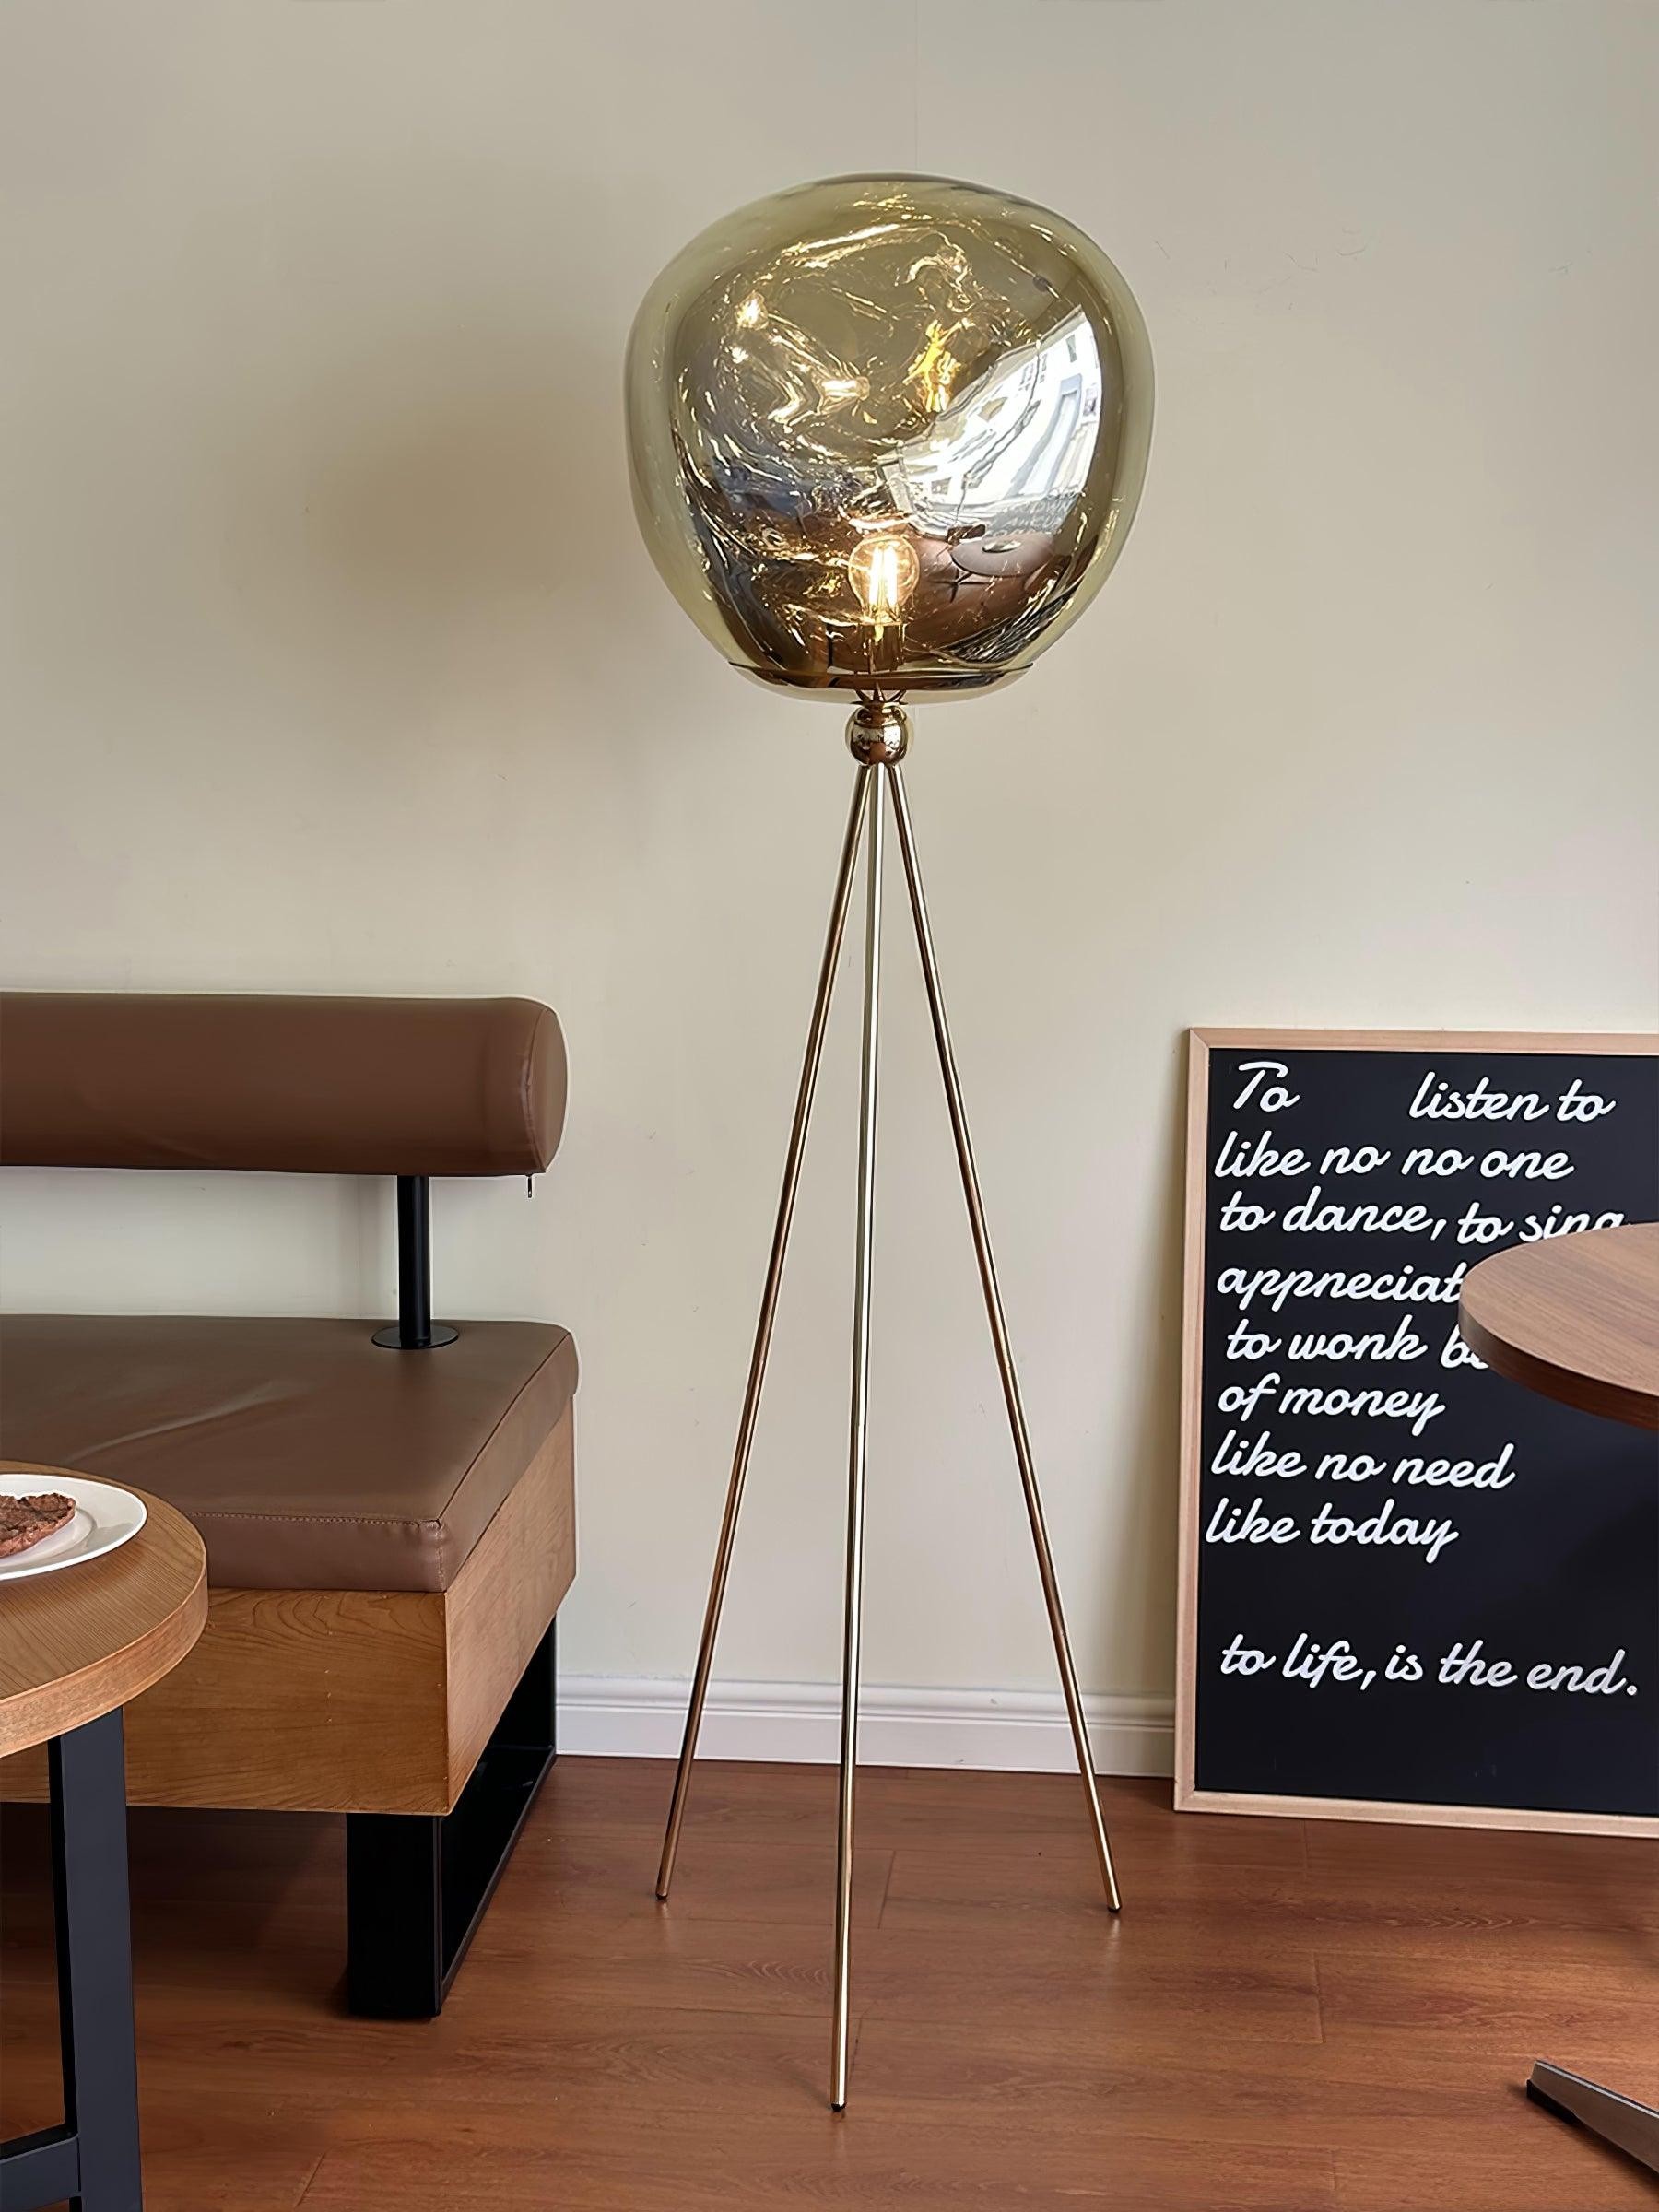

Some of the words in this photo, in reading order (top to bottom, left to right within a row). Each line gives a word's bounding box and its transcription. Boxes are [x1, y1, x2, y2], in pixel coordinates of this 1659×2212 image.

[1232, 1061, 1300, 1112] To
[1408, 1071, 1550, 1121] listen
[1556, 1078, 1617, 1123] to
[1214, 1130, 1312, 1178] like
[1319, 1147, 1392, 1175] no
[1401, 1148, 1475, 1176] no
[1479, 1150, 1575, 1180] one
[1219, 1190, 1277, 1232] to
[1282, 1185, 1447, 1241] dance,
[1456, 1201, 1515, 1245] to
[1226, 1318, 1282, 1360] to
[1218, 1371, 1281, 1422] of
[1278, 1388, 1446, 1437] money
[1210, 1429, 1308, 1478] like
[1314, 1451, 1387, 1482] no
[1391, 1442, 1516, 1489] need
[1205, 1497, 1301, 1544] like
[1309, 1498, 1460, 1564] today
[1220, 1633, 1277, 1676] to
[1281, 1632, 1377, 1691] life,
[1384, 1644, 1424, 1681] is
[1438, 1639, 1519, 1688] the
[1526, 1648, 1638, 1697] end.
